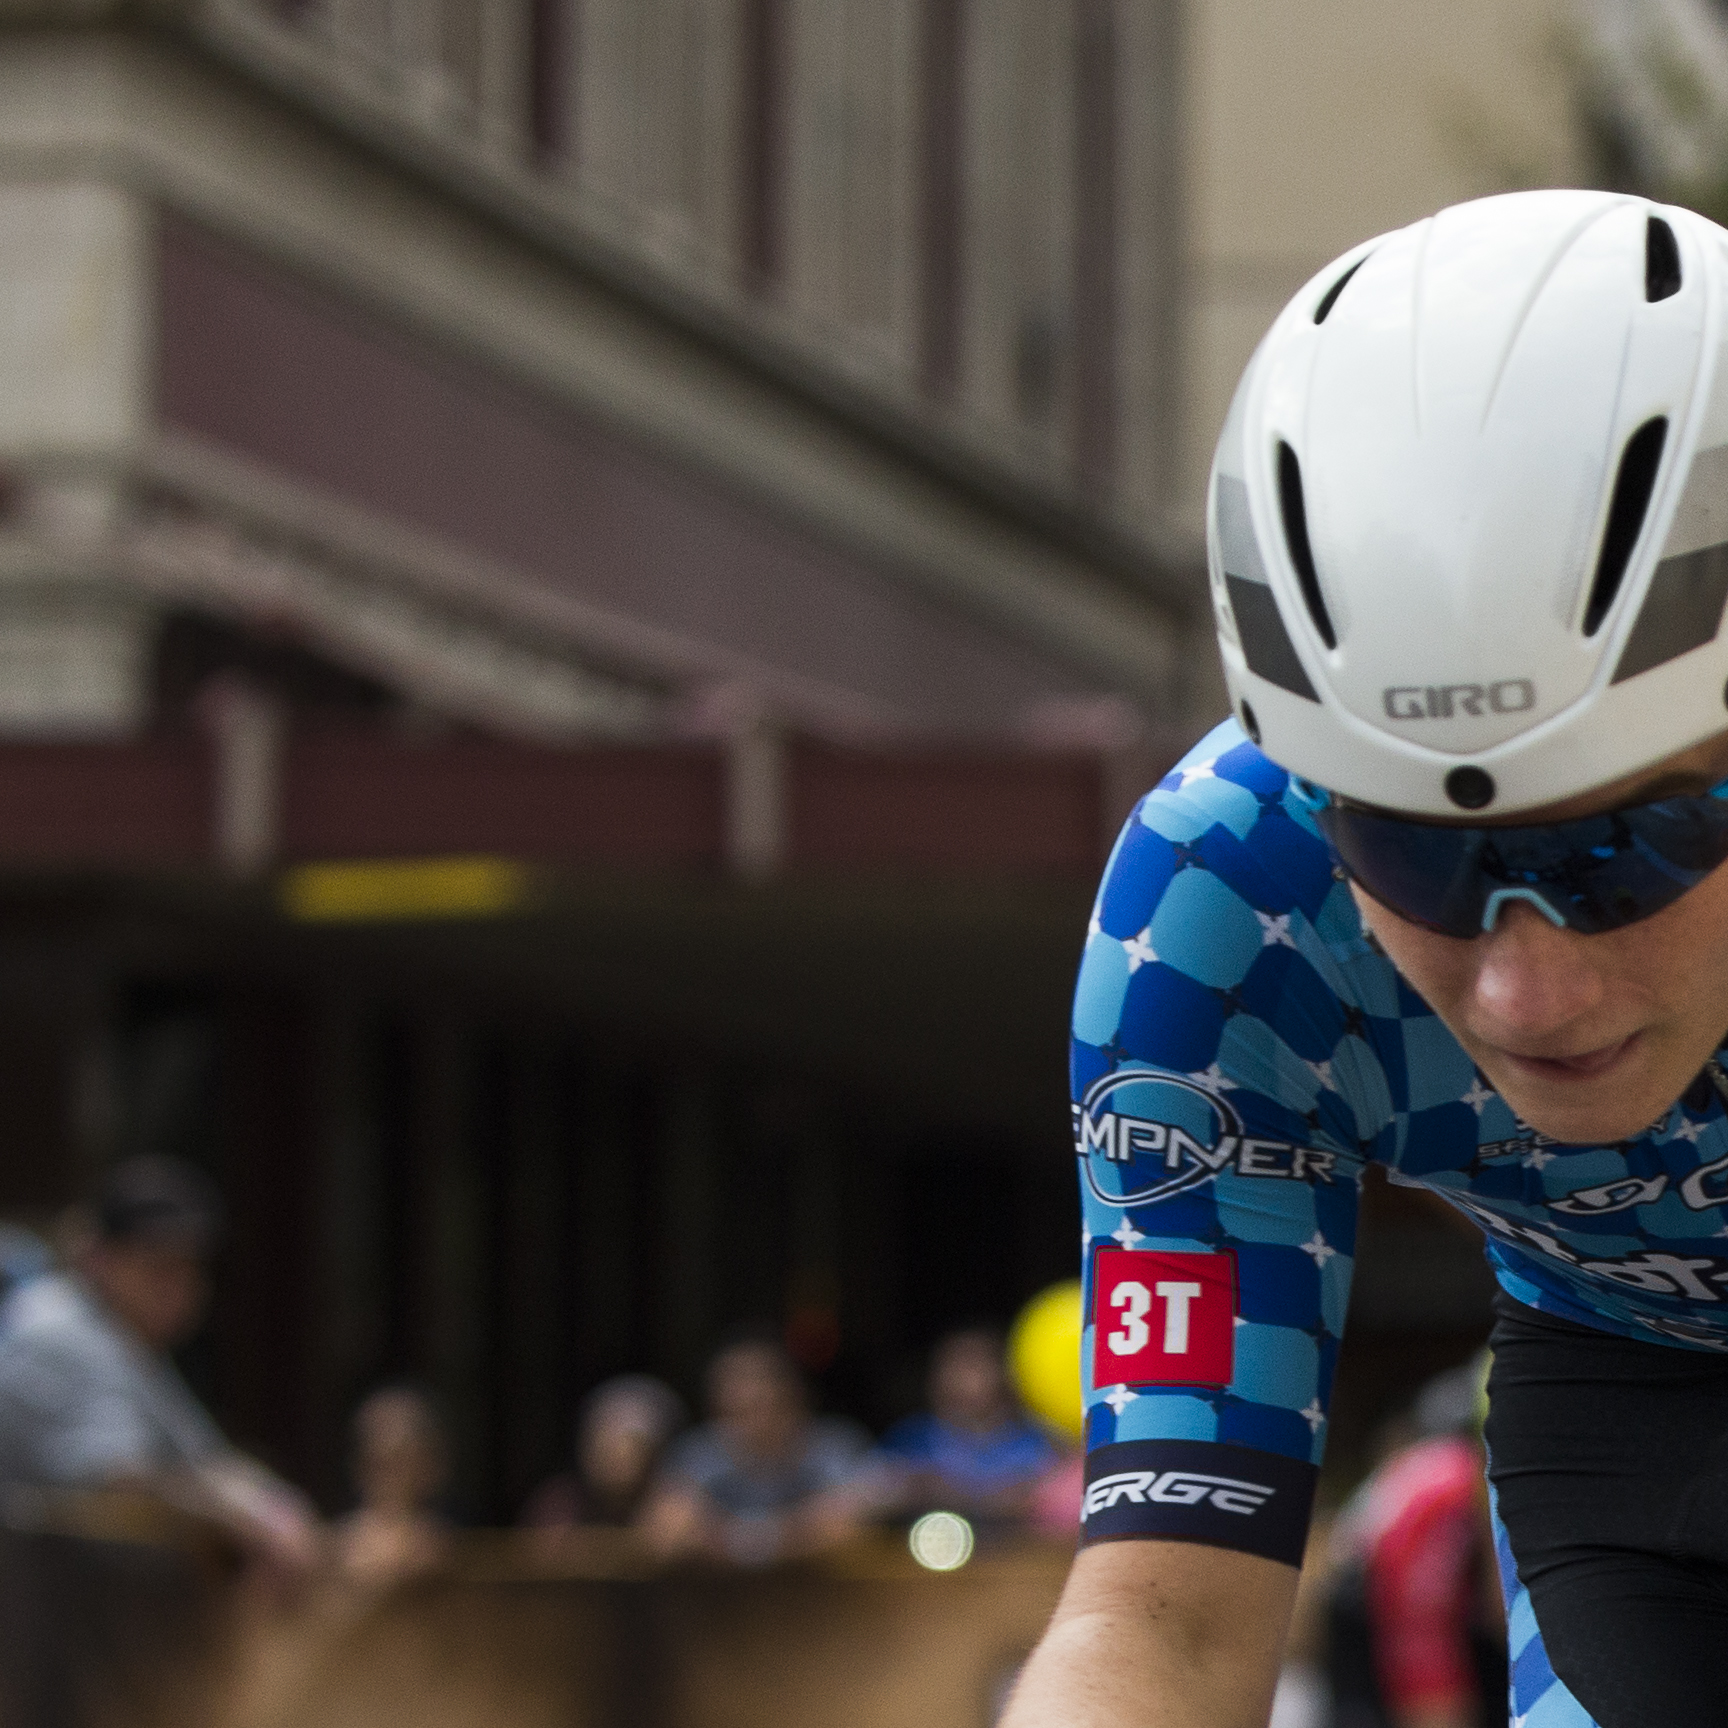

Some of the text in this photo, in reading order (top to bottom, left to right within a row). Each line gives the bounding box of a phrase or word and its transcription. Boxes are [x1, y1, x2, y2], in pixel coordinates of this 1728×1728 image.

[1384, 679, 1535, 720] GIRO
[1108, 1282, 1202, 1355] 3T
[1080, 1471, 1277, 1522] ERGE
